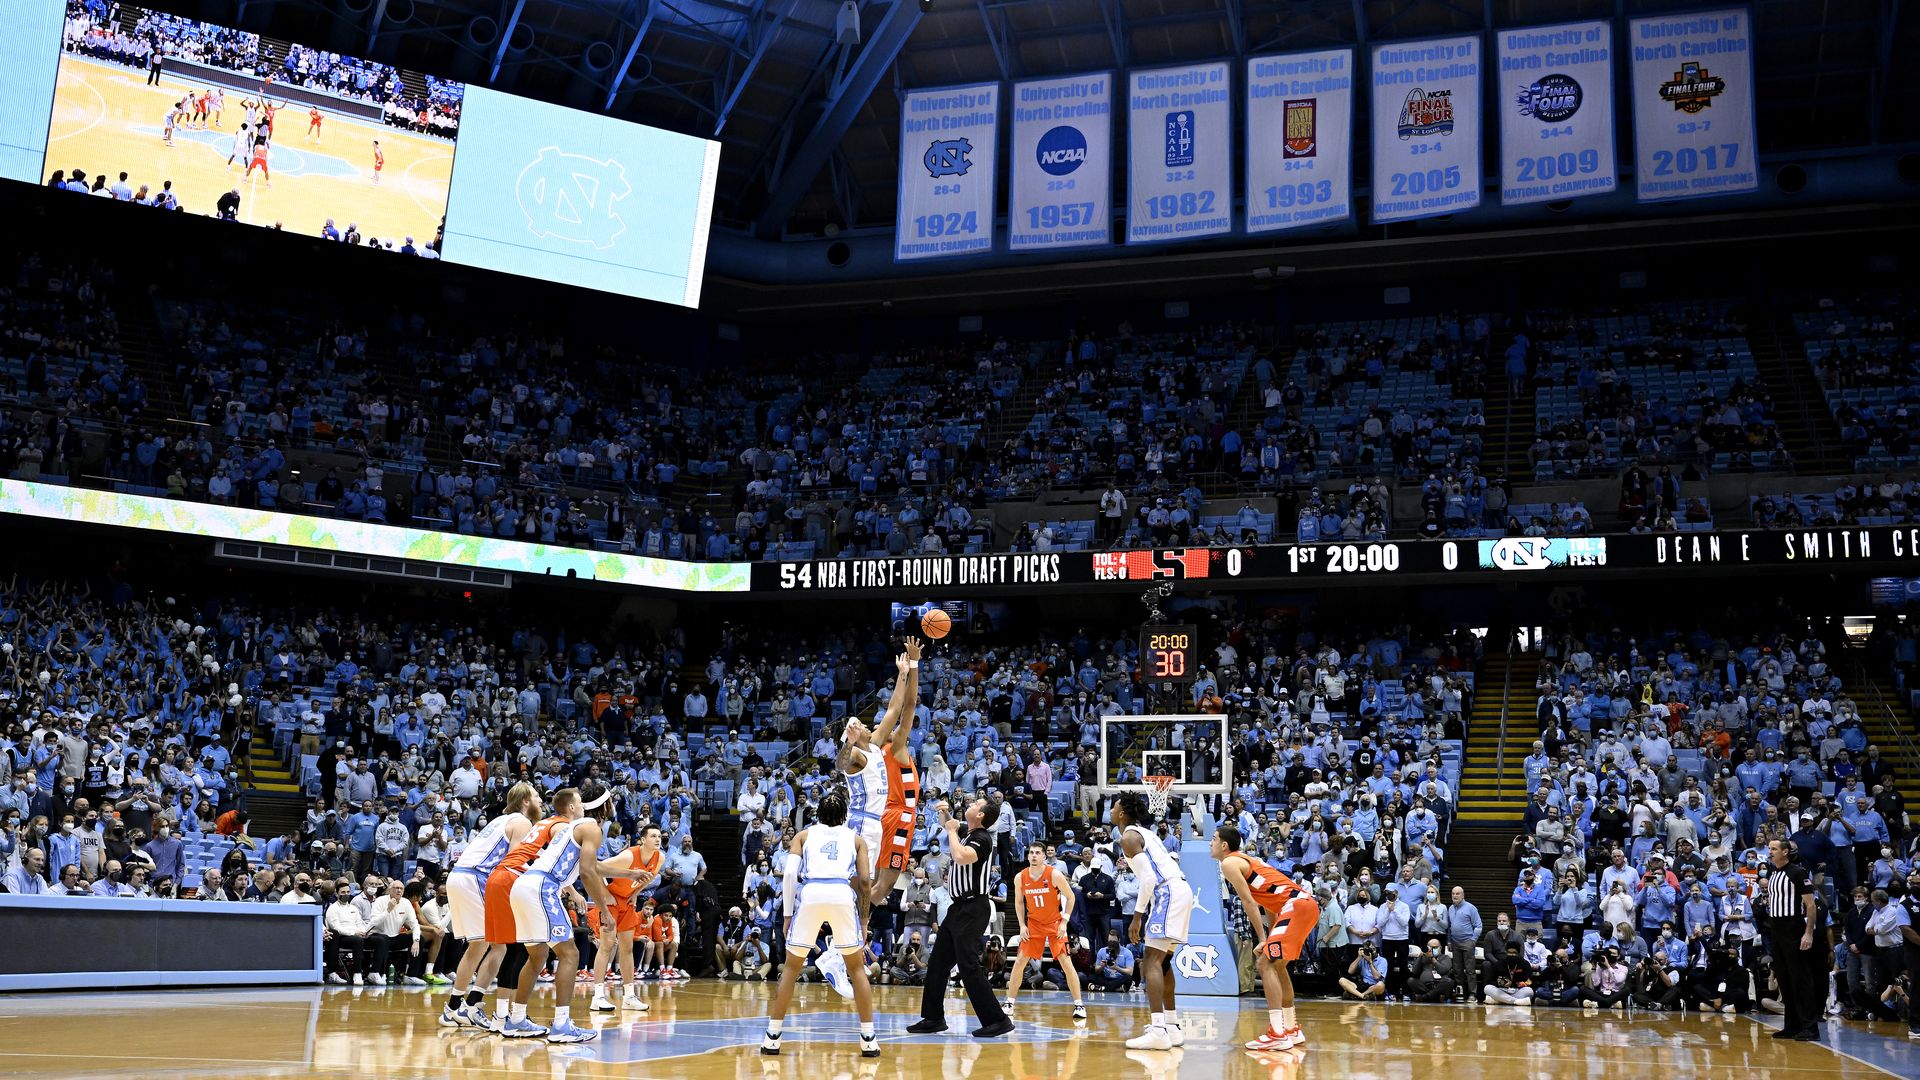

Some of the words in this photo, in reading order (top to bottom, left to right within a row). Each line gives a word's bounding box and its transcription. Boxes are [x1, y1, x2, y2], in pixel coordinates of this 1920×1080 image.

[1640, 18, 1719, 39] University
[1723, 15, 1737, 30] of
[1507, 30, 1582, 50] University
[1586, 27, 1600, 41] of
[1635, 43, 1676, 61] North
[1681, 37, 1746, 57] Carolina
[1380, 45, 1454, 65] University
[1457, 42, 1472, 56] of
[1502, 55, 1541, 71] North
[1546, 49, 1607, 67] Carolina
[1256, 59, 1327, 77] University
[1330, 55, 1344, 69] of
[1375, 69, 1414, 85] North
[1417, 63, 1476, 83] Carolina
[1138, 71, 1206, 90] University
[1209, 67, 1223, 81] of
[1250, 82, 1288, 98] North
[1291, 76, 1349, 95] Carolina
[1668, 84, 1692, 95] FINAL
[1693, 82, 1715, 92] FOUR
[1021, 83, 1088, 101] University
[1090, 80, 1104, 95] of
[1132, 95, 1168, 110] North
[1171, 88, 1227, 107] Carolina
[1427, 90, 1451, 98] NCAA
[1541, 85, 1575, 97] FINAL
[911, 92, 976, 112] University
[978, 92, 991, 105] of
[1016, 107, 1051, 121] North
[1054, 102, 1108, 118] Carolina
[1409, 98, 1450, 114] FINAL
[1529, 94, 1576, 111] FOUR
[906, 117, 939, 132] North
[942, 112, 994, 129] Carolina
[1041, 148, 1085, 164] NCAA
[1410, 142, 1441, 155] 33-4
[1516, 149, 1598, 182] 2009
[1653, 143, 1738, 177] 2017
[1166, 170, 1194, 182] 32-2
[1391, 166, 1460, 196] 2005
[1641, 180, 1689, 193] NATIONAL
[1692, 173, 1753, 188] CHAMPIONS
[1265, 180, 1332, 208] 1993
[1504, 185, 1550, 199] NATIONAL
[1552, 177, 1612, 195] CHAMPIONS
[1146, 191, 1215, 219] 1982
[1375, 200, 1420, 213] NATIONAL
[1421, 191, 1476, 209] CHAMPIONS
[915, 211, 977, 237] 1924
[1027, 202, 1094, 228] 1957
[1250, 213, 1291, 225] NATIONAL
[1293, 204, 1346, 221] CHAMPIONS
[1013, 233, 1053, 244] NATIONAL
[1055, 229, 1106, 243] CHAMPIONS
[1132, 223, 1173, 235] NATIONAL
[1175, 218, 1228, 233] CHAMPIONS
[901, 242, 939, 254] NATIONAL
[940, 238, 989, 251] CHAMPIONS
[1443, 542, 1457, 570] 0
[1657, 536, 1720, 563] DEAN
[1742, 534, 1749, 561] E
[1785, 531, 1870, 559] SMITH
[1094, 553, 1118, 566] TOL:
[1119, 552, 1127, 564] 4
[1227, 549, 1242, 576] 0
[1288, 547, 1316, 572] 1ST
[1326, 544, 1399, 572] 20:00
[1570, 552, 1596, 566] FLS:
[1598, 552, 1606, 565] 0
[780, 563, 811, 588] 54
[818, 561, 846, 588] NBA
[853, 558, 952, 587] FIRST-ROUND
[959, 556, 1007, 584] DRAFT
[1013, 554, 1060, 583] PICKS
[1095, 567, 1117, 580] FLS:
[1118, 567, 1126, 579] 0
[1150, 634, 1188, 649] 20:00
[1156, 651, 1184, 676] 30
[91, 772, 102, 781] 23
[84, 838, 98, 846] UNC
[820, 841, 838, 860] 4
[1033, 895, 1044, 907] 11
